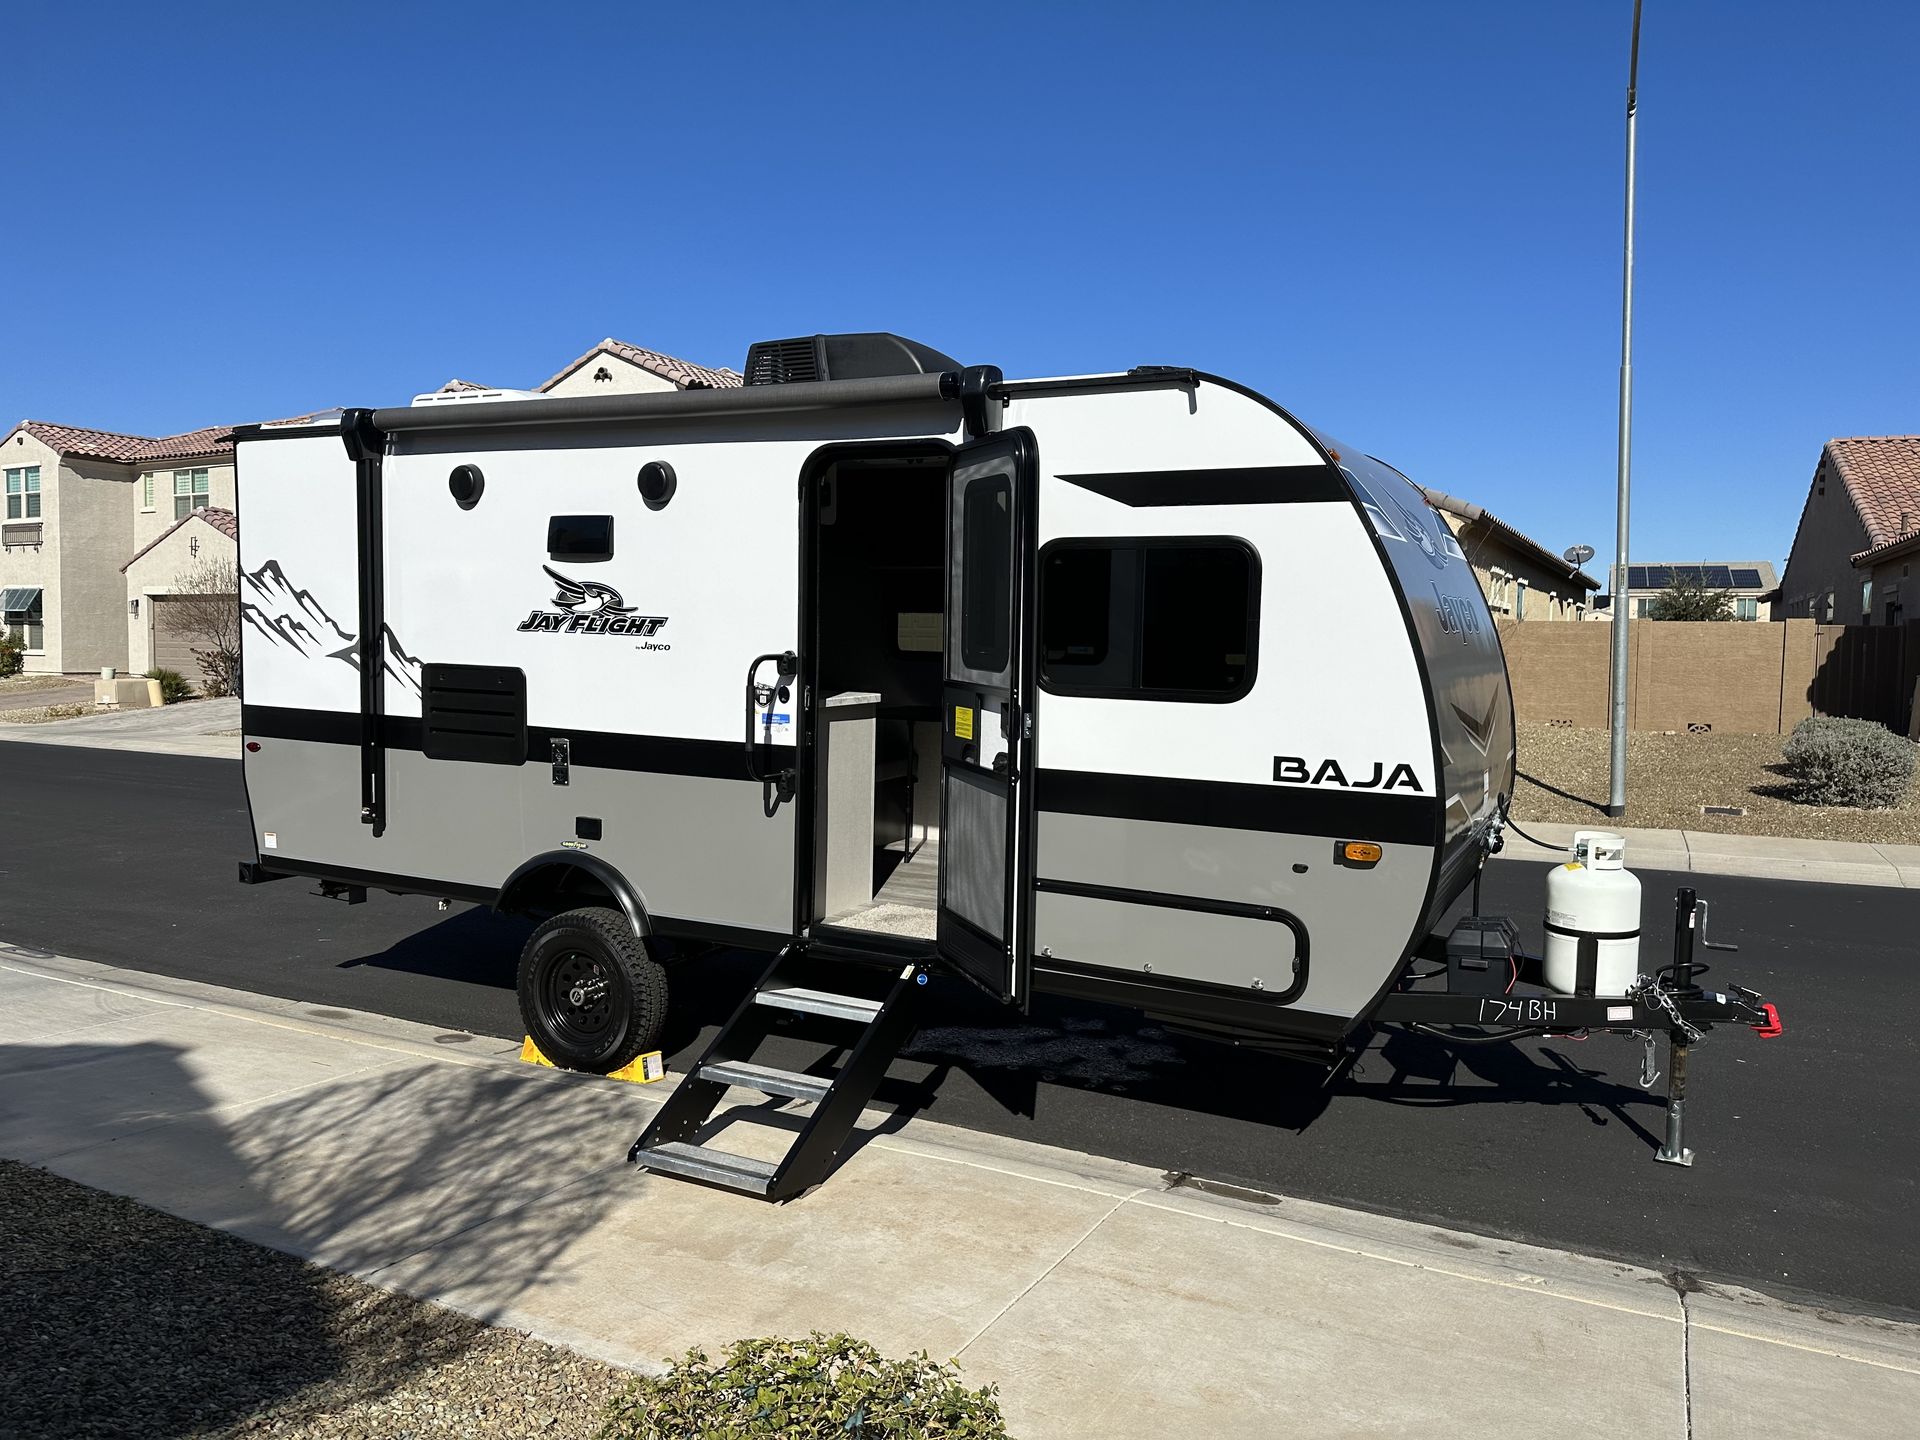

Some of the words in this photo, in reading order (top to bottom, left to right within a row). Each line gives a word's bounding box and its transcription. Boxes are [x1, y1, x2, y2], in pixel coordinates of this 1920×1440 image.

[517, 610, 572, 633] JAY
[564, 613, 669, 637] FLIGHT
[1429, 579, 1480, 646] Jayco
[640, 641, 671, 652] Jayco
[1273, 755, 1425, 793] BAJA
[1479, 998, 1556, 1022] 174BH
